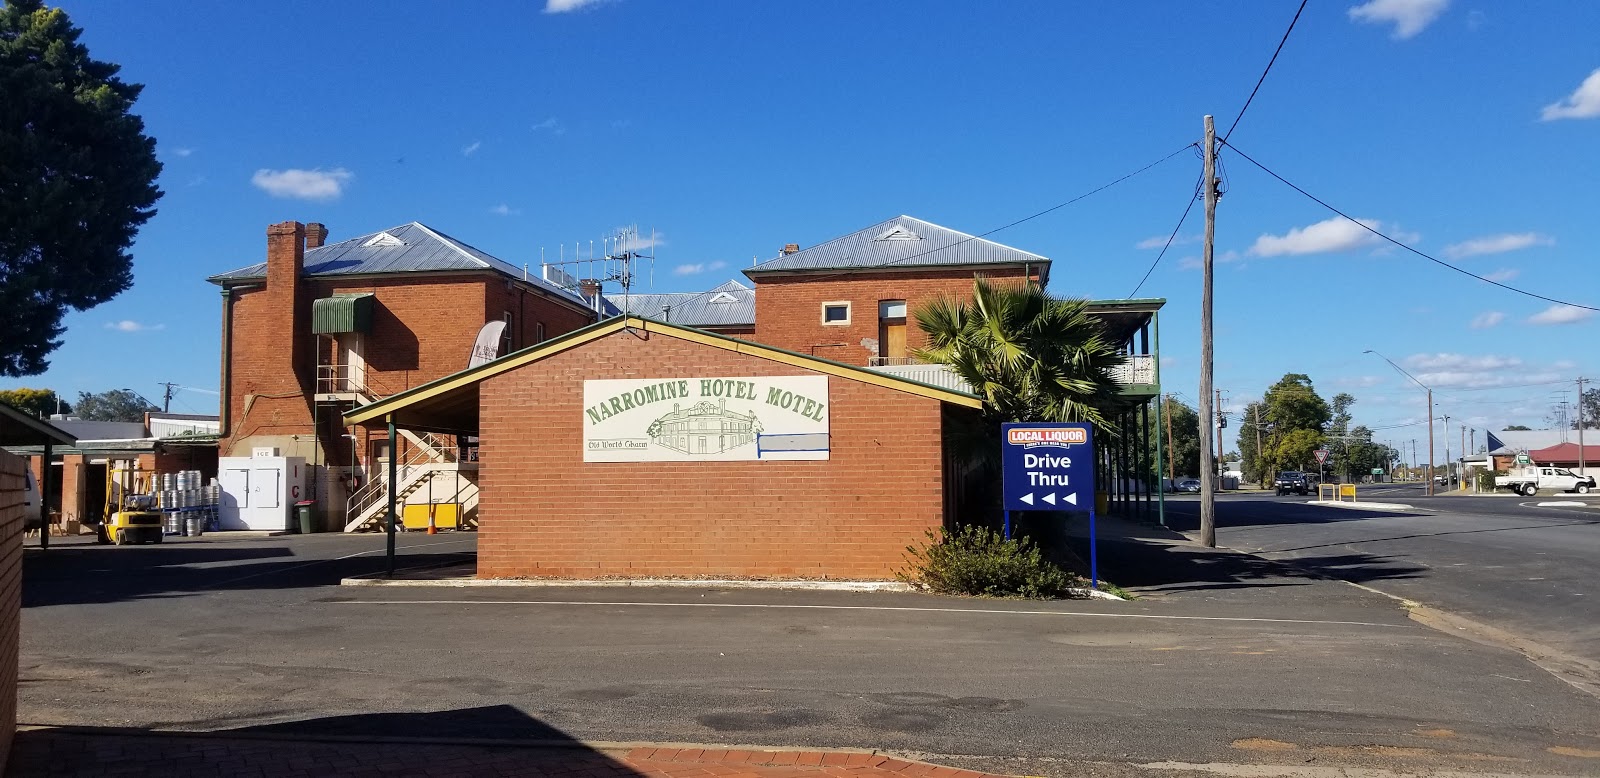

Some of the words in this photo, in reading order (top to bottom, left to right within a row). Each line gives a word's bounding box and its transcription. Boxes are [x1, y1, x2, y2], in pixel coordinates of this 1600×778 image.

[586, 380, 689, 425] NARROMINE
[700, 379, 757, 400] HOTEL
[766, 387, 825, 422] MOTEL
[1012, 431, 1044, 441] LOCAL
[1024, 453, 1071, 468] Drive
[1027, 472, 1069, 486] Thru
